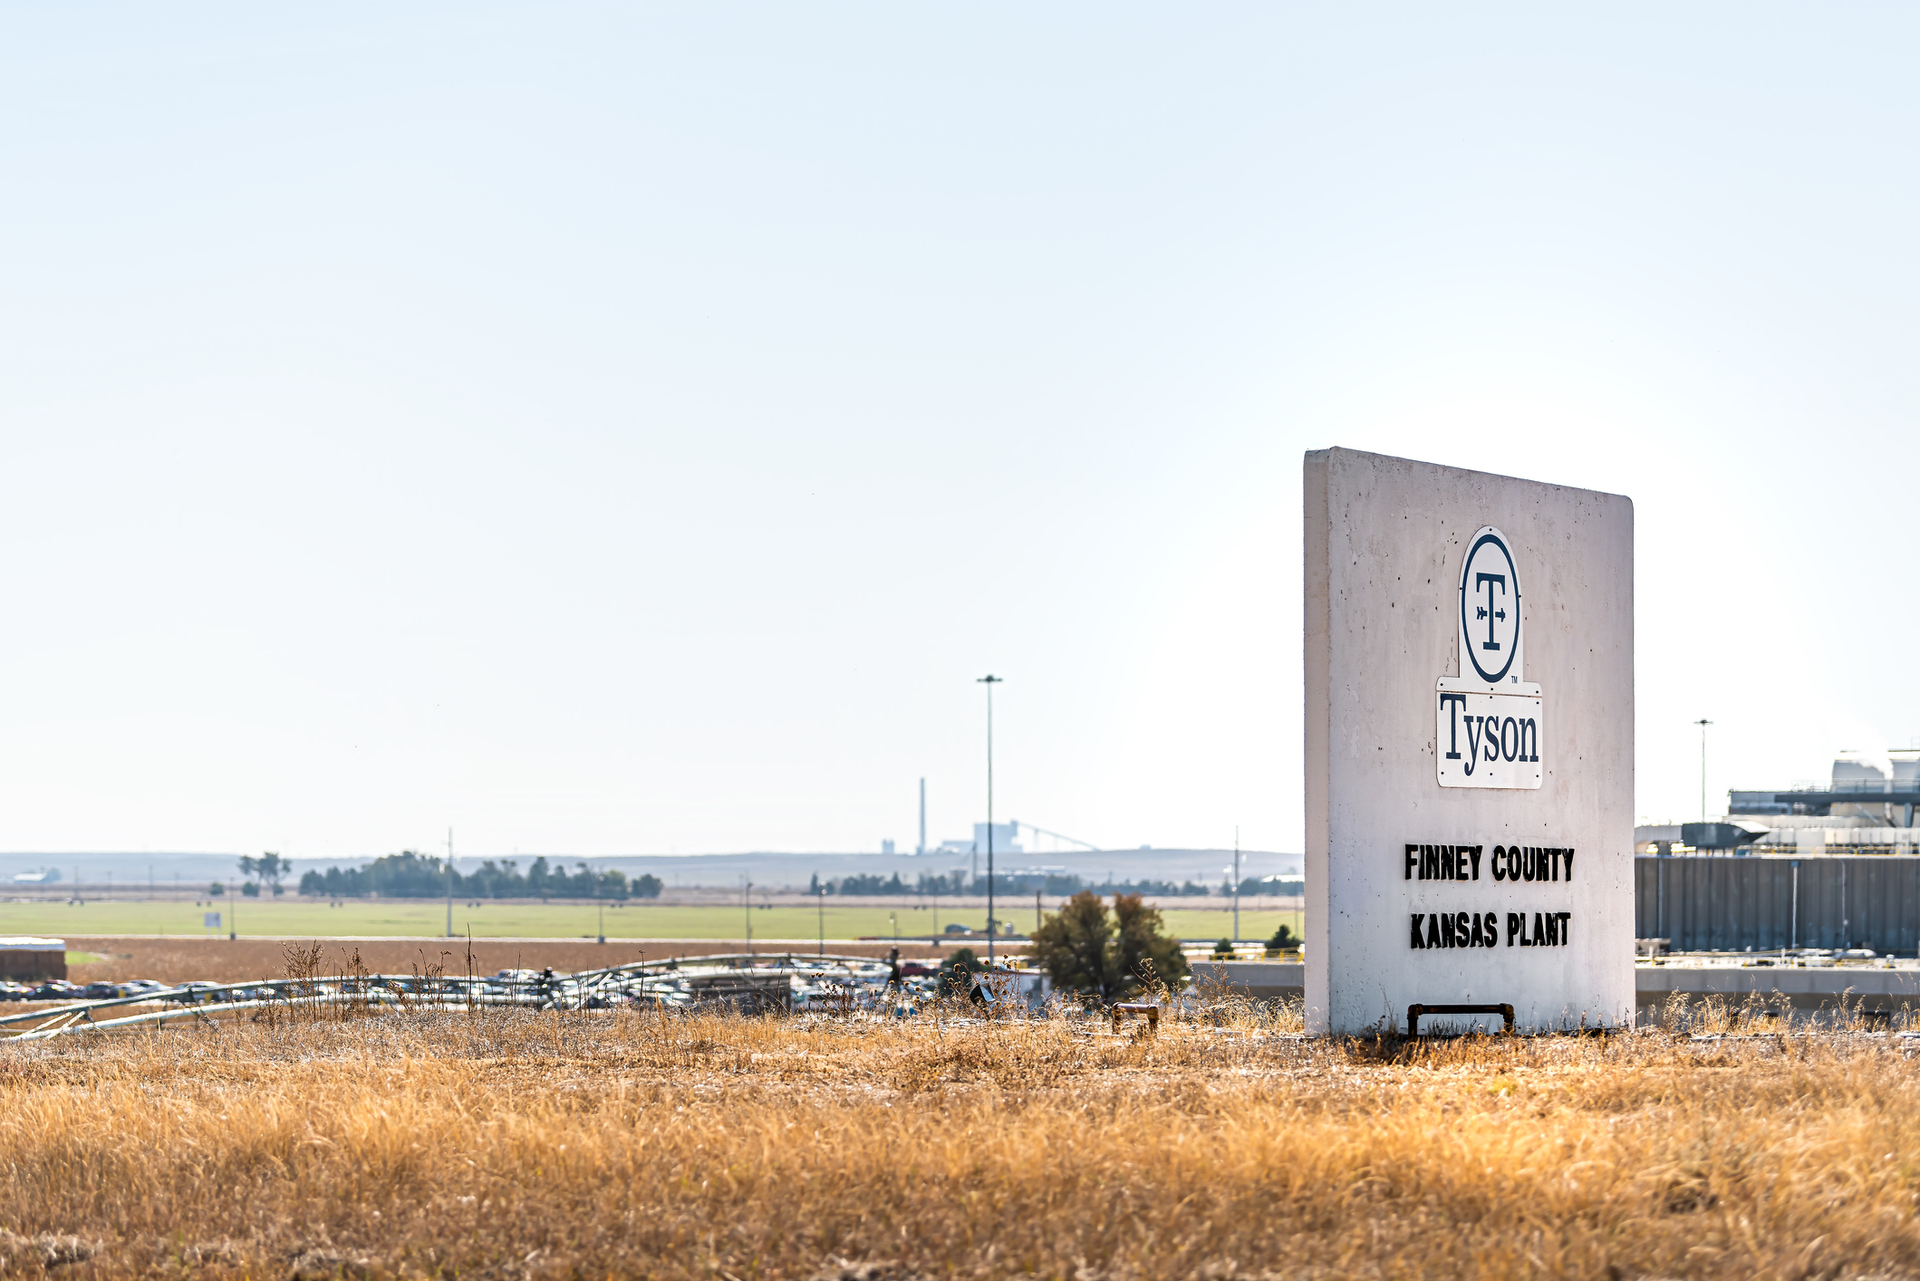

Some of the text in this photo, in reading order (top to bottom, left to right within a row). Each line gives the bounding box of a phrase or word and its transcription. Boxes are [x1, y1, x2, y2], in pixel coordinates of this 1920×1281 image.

[1476, 572, 1505, 651] T
[1511, 675, 1518, 684] TM
[1440, 693, 1539, 776] Tyson
[1405, 844, 1575, 881] FINNEY COUNTY
[1410, 912, 1571, 949] KANSAS PLANT
